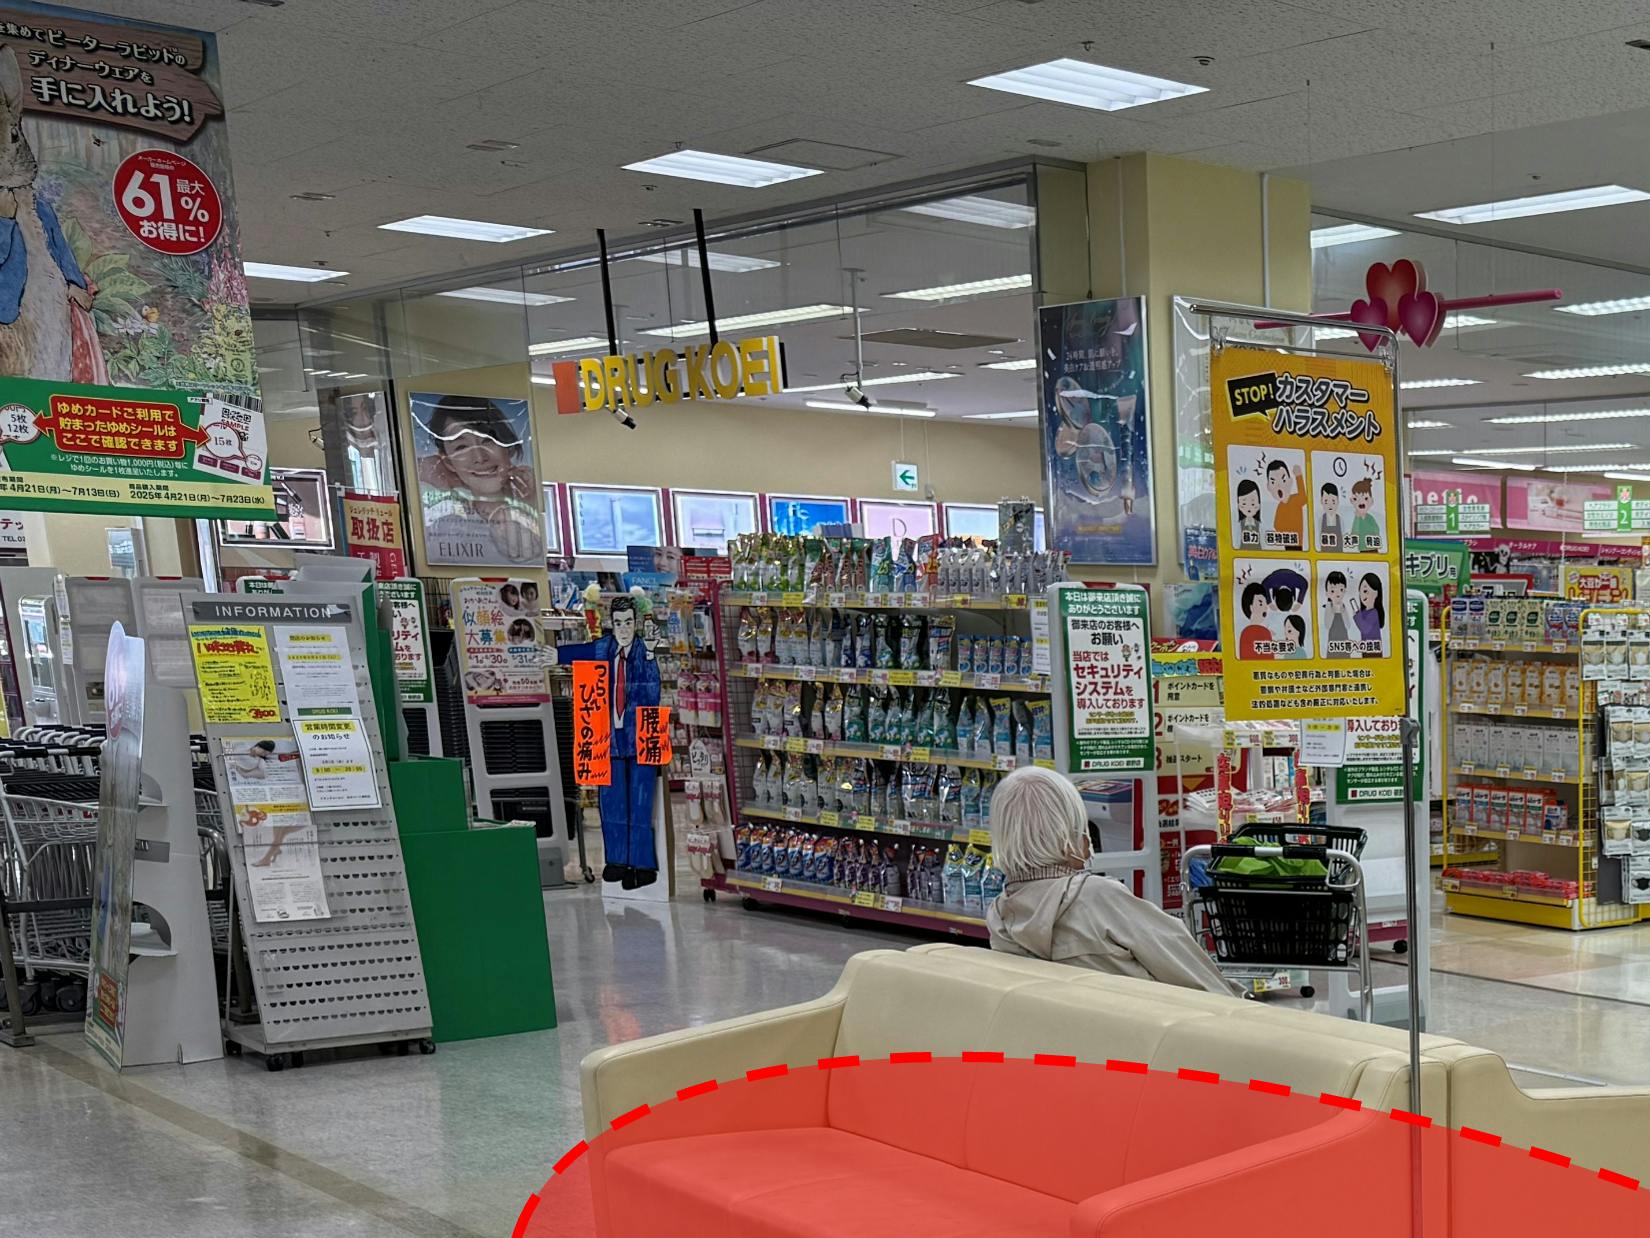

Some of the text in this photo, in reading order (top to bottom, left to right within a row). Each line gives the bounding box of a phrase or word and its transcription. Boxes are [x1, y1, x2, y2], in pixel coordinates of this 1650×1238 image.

[28, 50, 153, 84] ディナーウェアを
[31, 77, 192, 122] 手に入れよう!
[122, 170, 175, 220] 61
[176, 179, 205, 195] 最大
[140, 220, 205, 242] お得に!
[580, 336, 785, 412] DRUG KOEI
[1234, 383, 1273, 406] STOP!
[1275, 373, 1369, 407] カスタマー
[10, 414, 27, 423] 5枚
[57, 402, 174, 421] ゆめカードご利用で
[7, 424, 29, 434] 12枚
[59, 418, 177, 437] 貯まったゆめシールは
[221, 419, 249, 431] SAMPLE
[1272, 406, 1382, 441] ハラスメント
[62, 433, 178, 451] ここで確認できます
[1449, 513, 1456, 527] 1
[1620, 511, 1628, 525] 2
[351, 517, 395, 544] 取扱店
[1344, 535, 1359, 546] 大声
[439, 542, 484, 558] ELIXIR
[1065, 592, 1141, 602] 本日は御来店頂き誠に
[215, 605, 333, 619] INFORMATION
[1068, 605, 1140, 615] ありがとうございます
[463, 611, 504, 627] 似顔絵
[1071, 620, 1140, 631] 御来店のお客様へ
[465, 629, 507, 645] 大募集
[1091, 633, 1124, 645] お願い
[1255, 642, 1295, 652] 不当な要求
[1073, 651, 1109, 662] 当店では
[1073, 664, 1144, 679] セキュリティ
[1075, 682, 1134, 696] システムを
[1077, 699, 1144, 710] 導入しております
[639, 708, 662, 764] 腰痛
